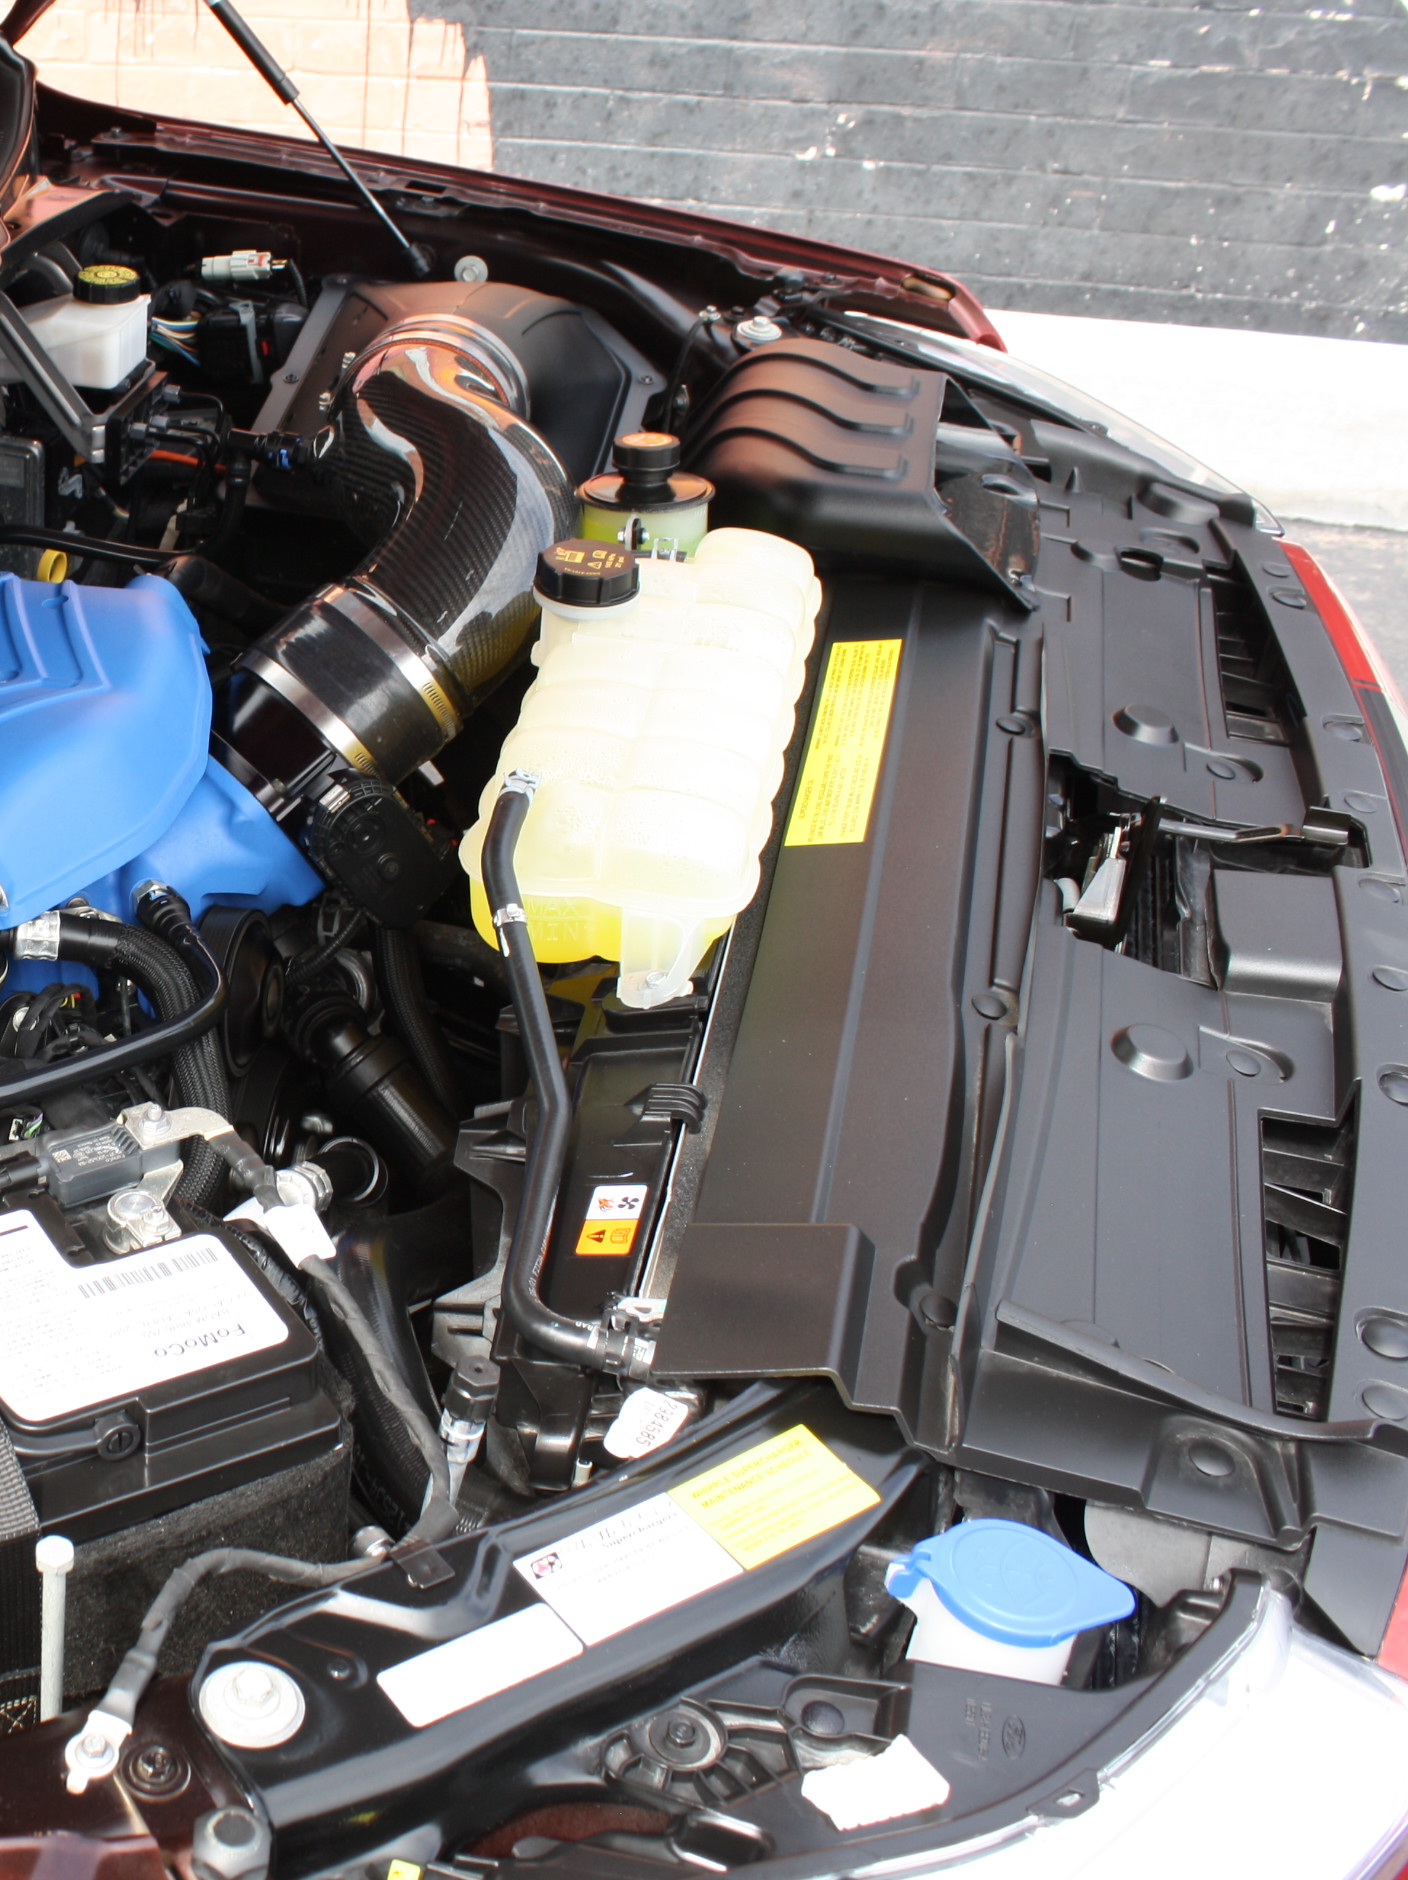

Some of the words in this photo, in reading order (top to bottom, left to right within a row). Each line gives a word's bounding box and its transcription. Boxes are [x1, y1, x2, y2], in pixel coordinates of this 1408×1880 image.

[149, 1321, 245, 1363] FoMoCo
[689, 1473, 731, 1500] WHIPPLE
[731, 1437, 802, 1479] SUPERCHARGER
[699, 1471, 765, 1510] MAINTENANCE
[763, 1447, 811, 1477] SCHEDULE
